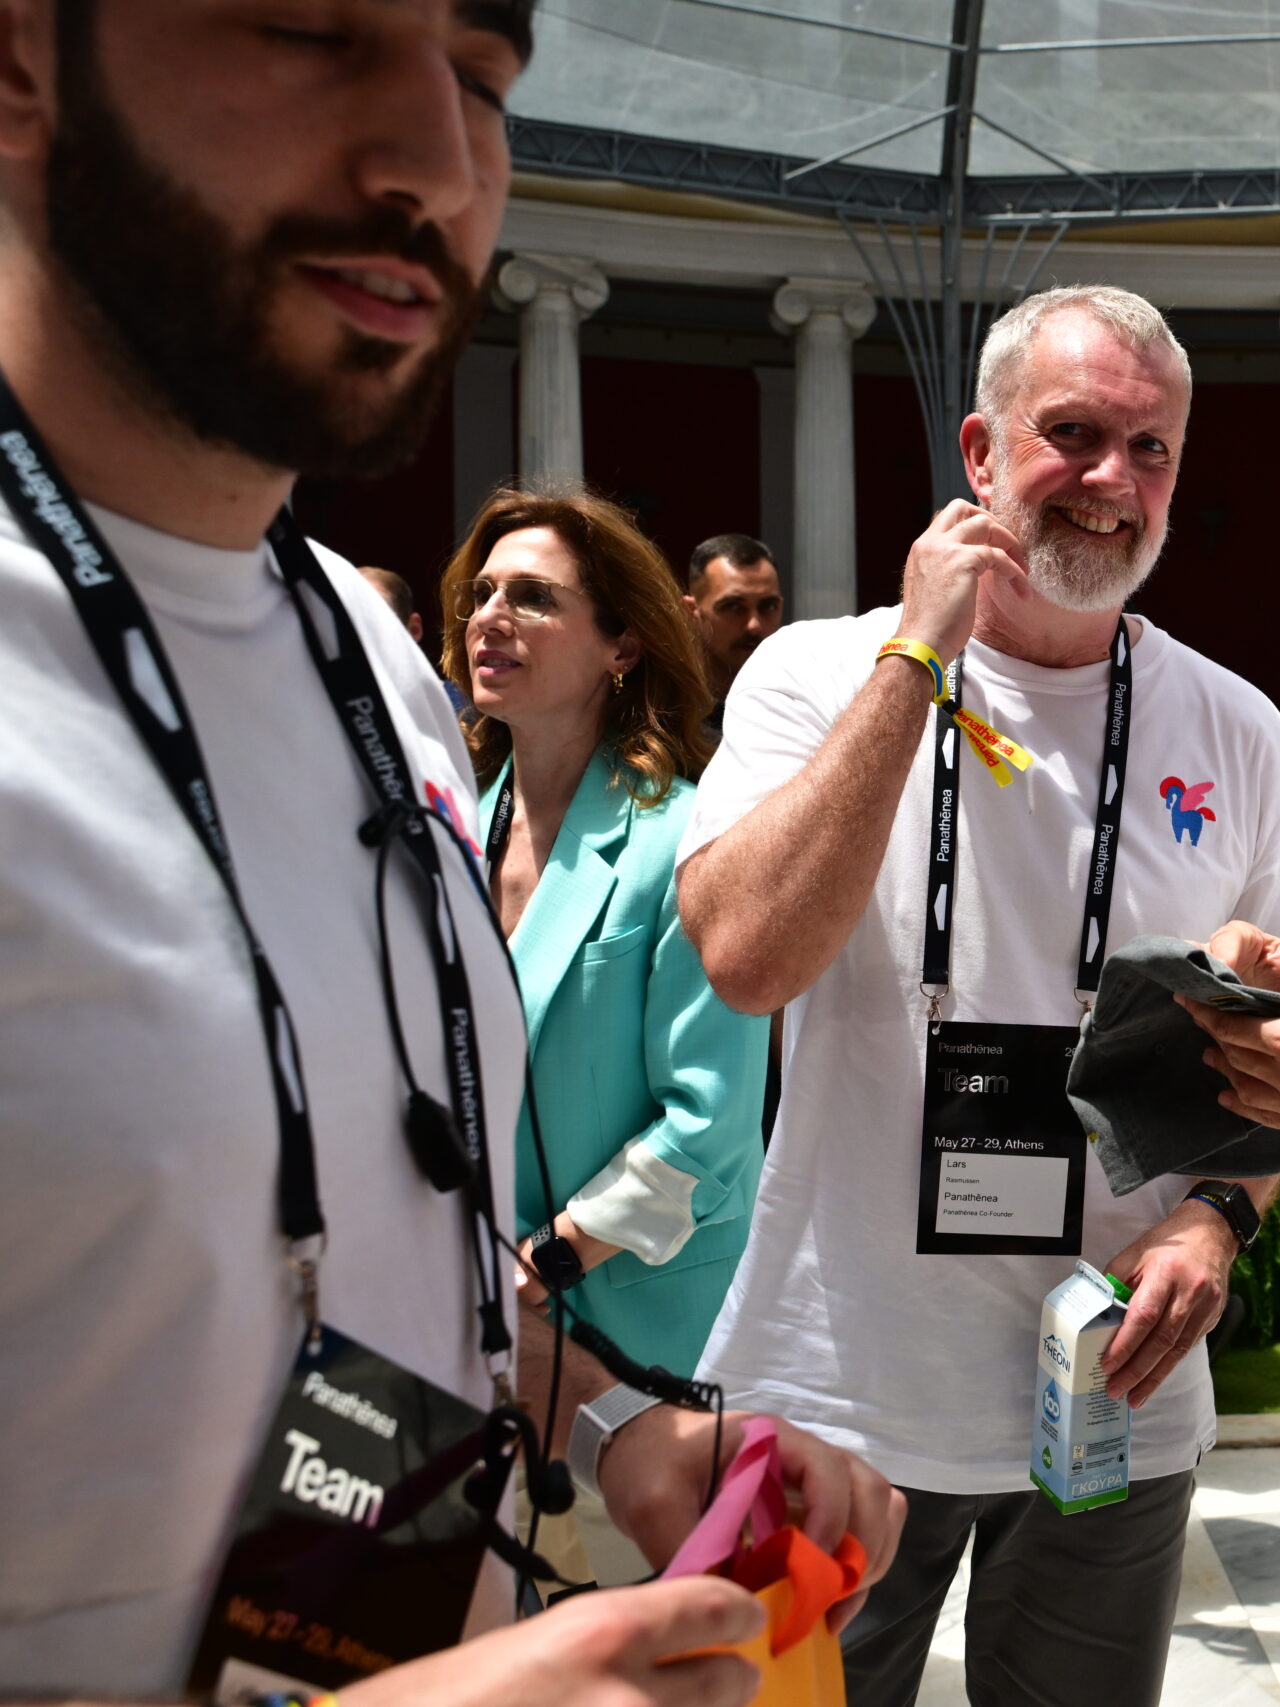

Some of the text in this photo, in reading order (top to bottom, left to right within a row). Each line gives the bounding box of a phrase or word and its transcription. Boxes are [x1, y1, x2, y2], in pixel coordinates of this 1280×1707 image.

[1110, 682, 1127, 746] Panathēnea
[936, 789, 952, 862] Panathēnea
[1093, 823, 1114, 895] Panathēnea
[938, 1068, 1009, 1093] Team
[934, 1136, 959, 1150] May
[1004, 1139, 1044, 1150] Athens
[947, 1159, 967, 1168] Lars
[1042, 1338, 1071, 1373] THEONI
[280, 1429, 384, 1528] Team
